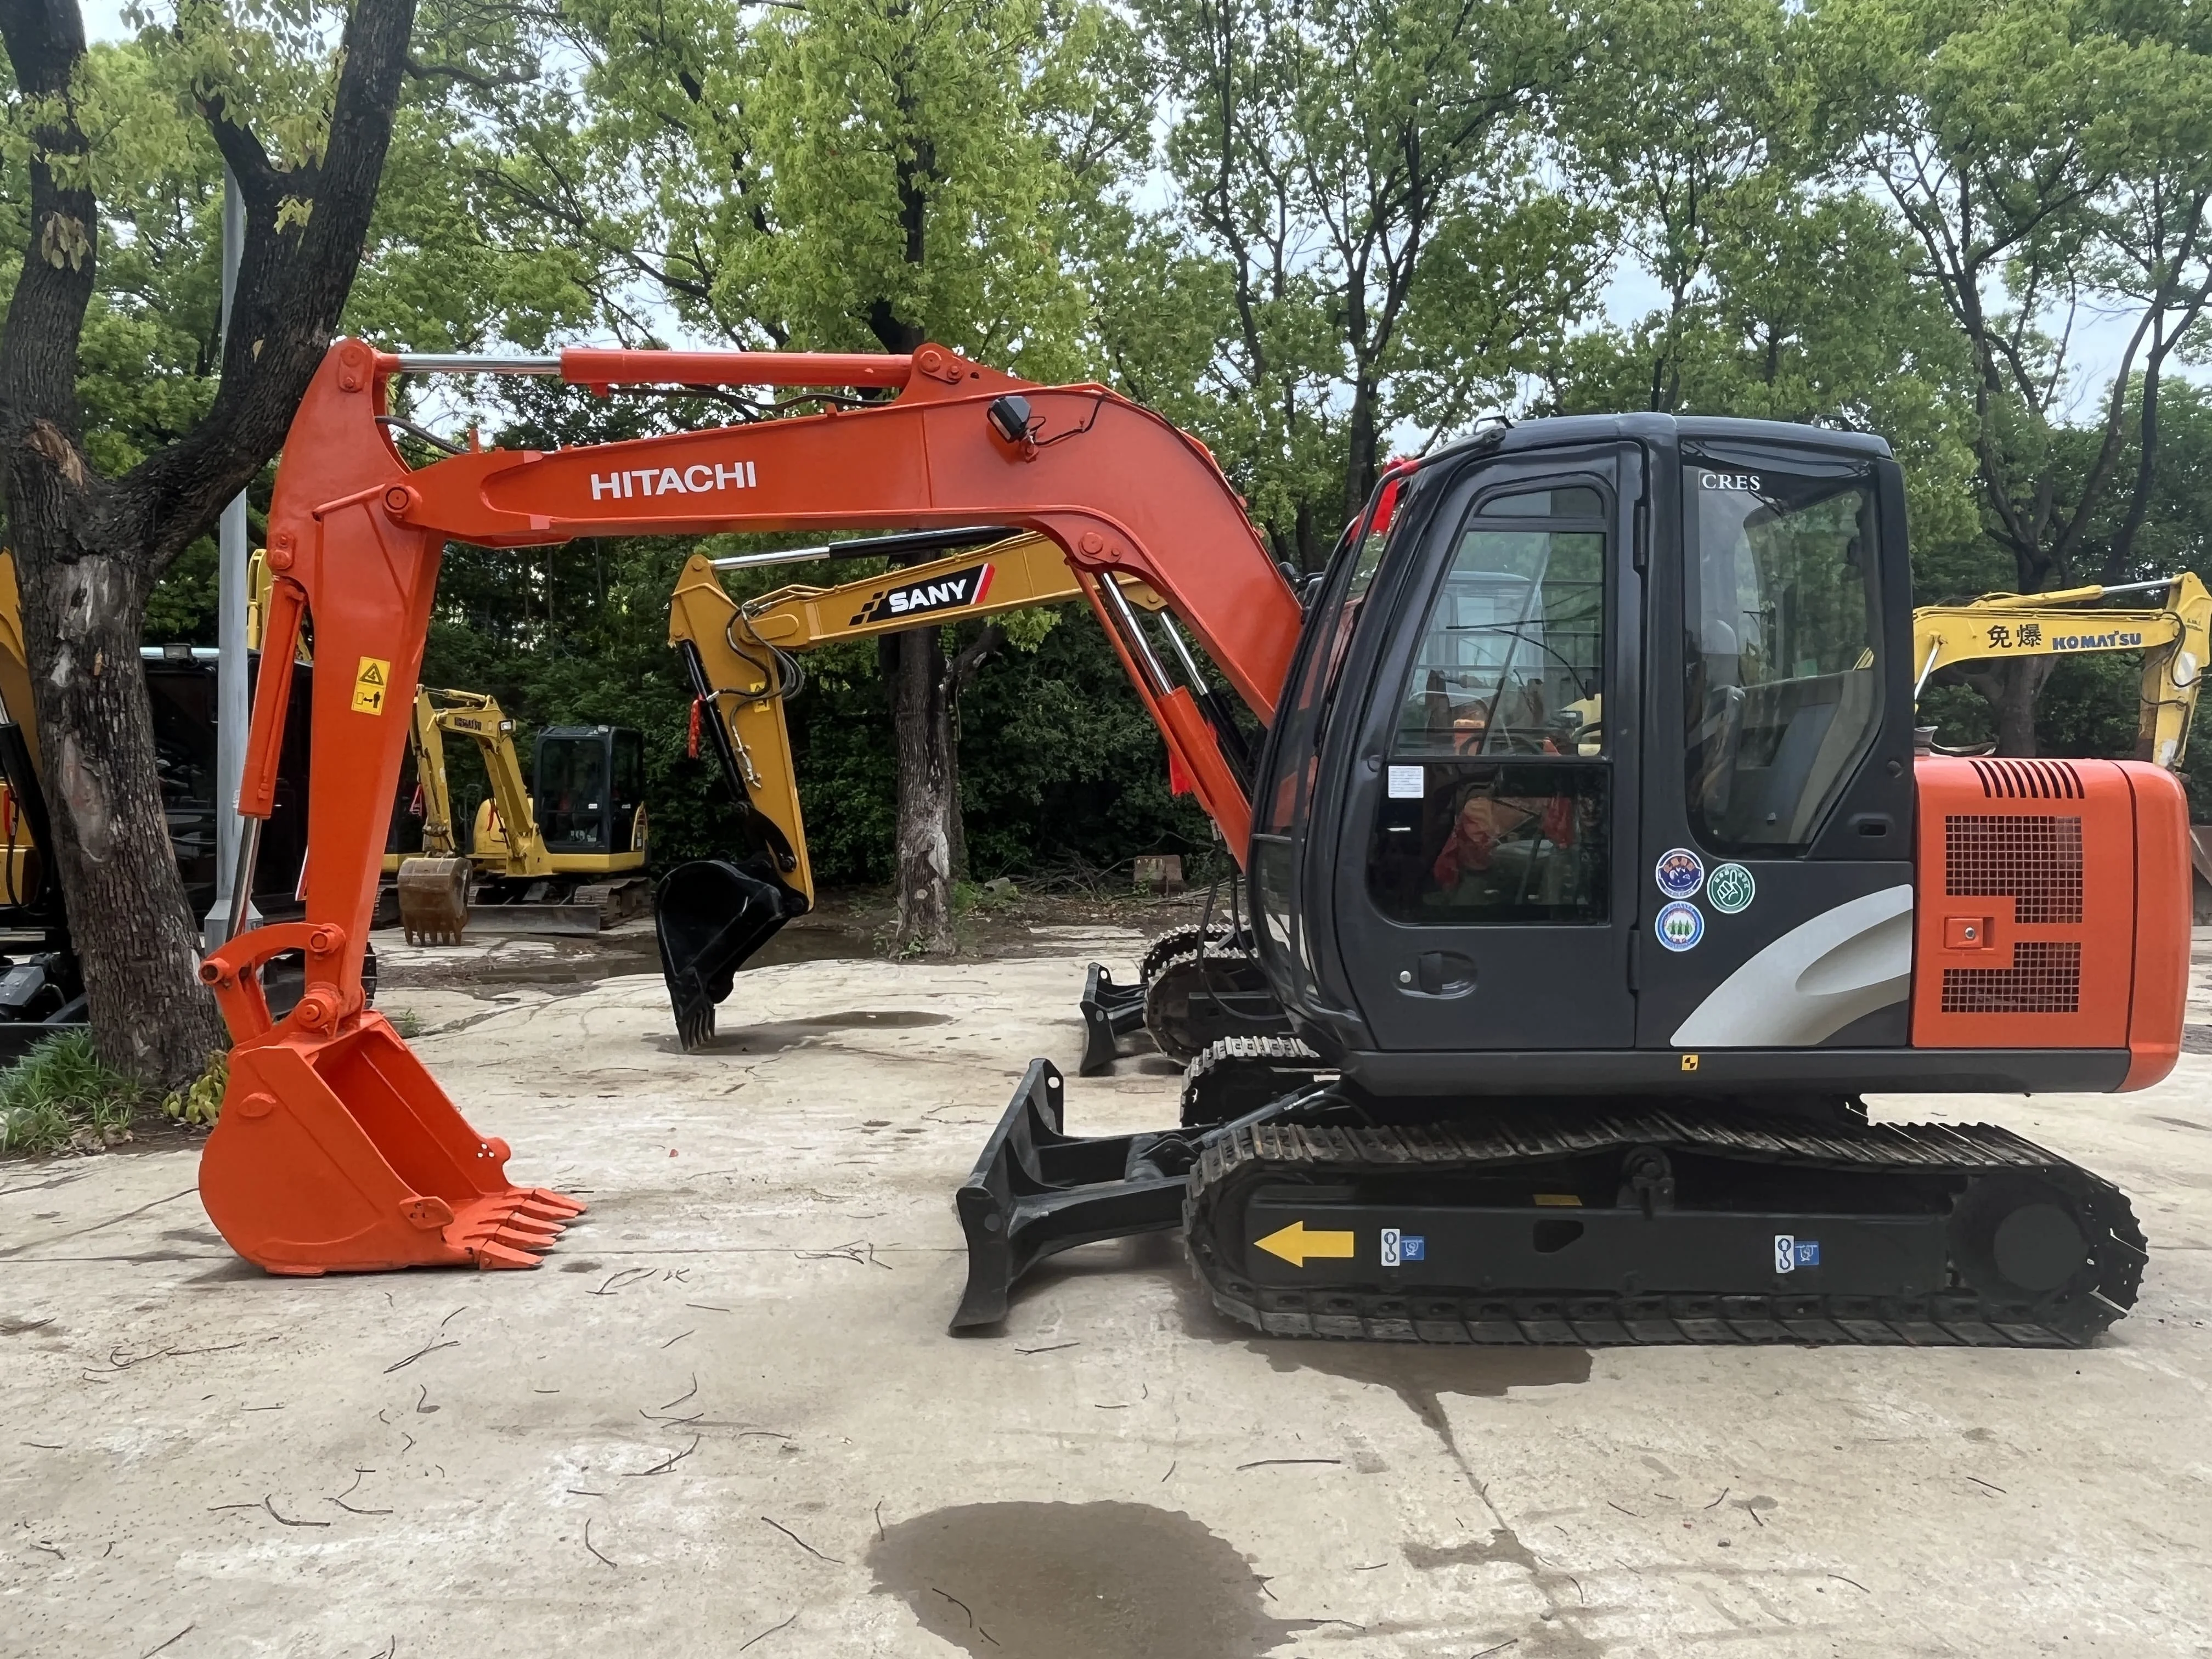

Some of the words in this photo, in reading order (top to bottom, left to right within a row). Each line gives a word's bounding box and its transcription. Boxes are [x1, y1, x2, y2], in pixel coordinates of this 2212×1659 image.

[591, 461, 757, 500] HITACHI
[1702, 474, 1760, 490] CRES
[889, 579, 967, 613] SANY
[2052, 630, 2141, 650] KOMATSU
